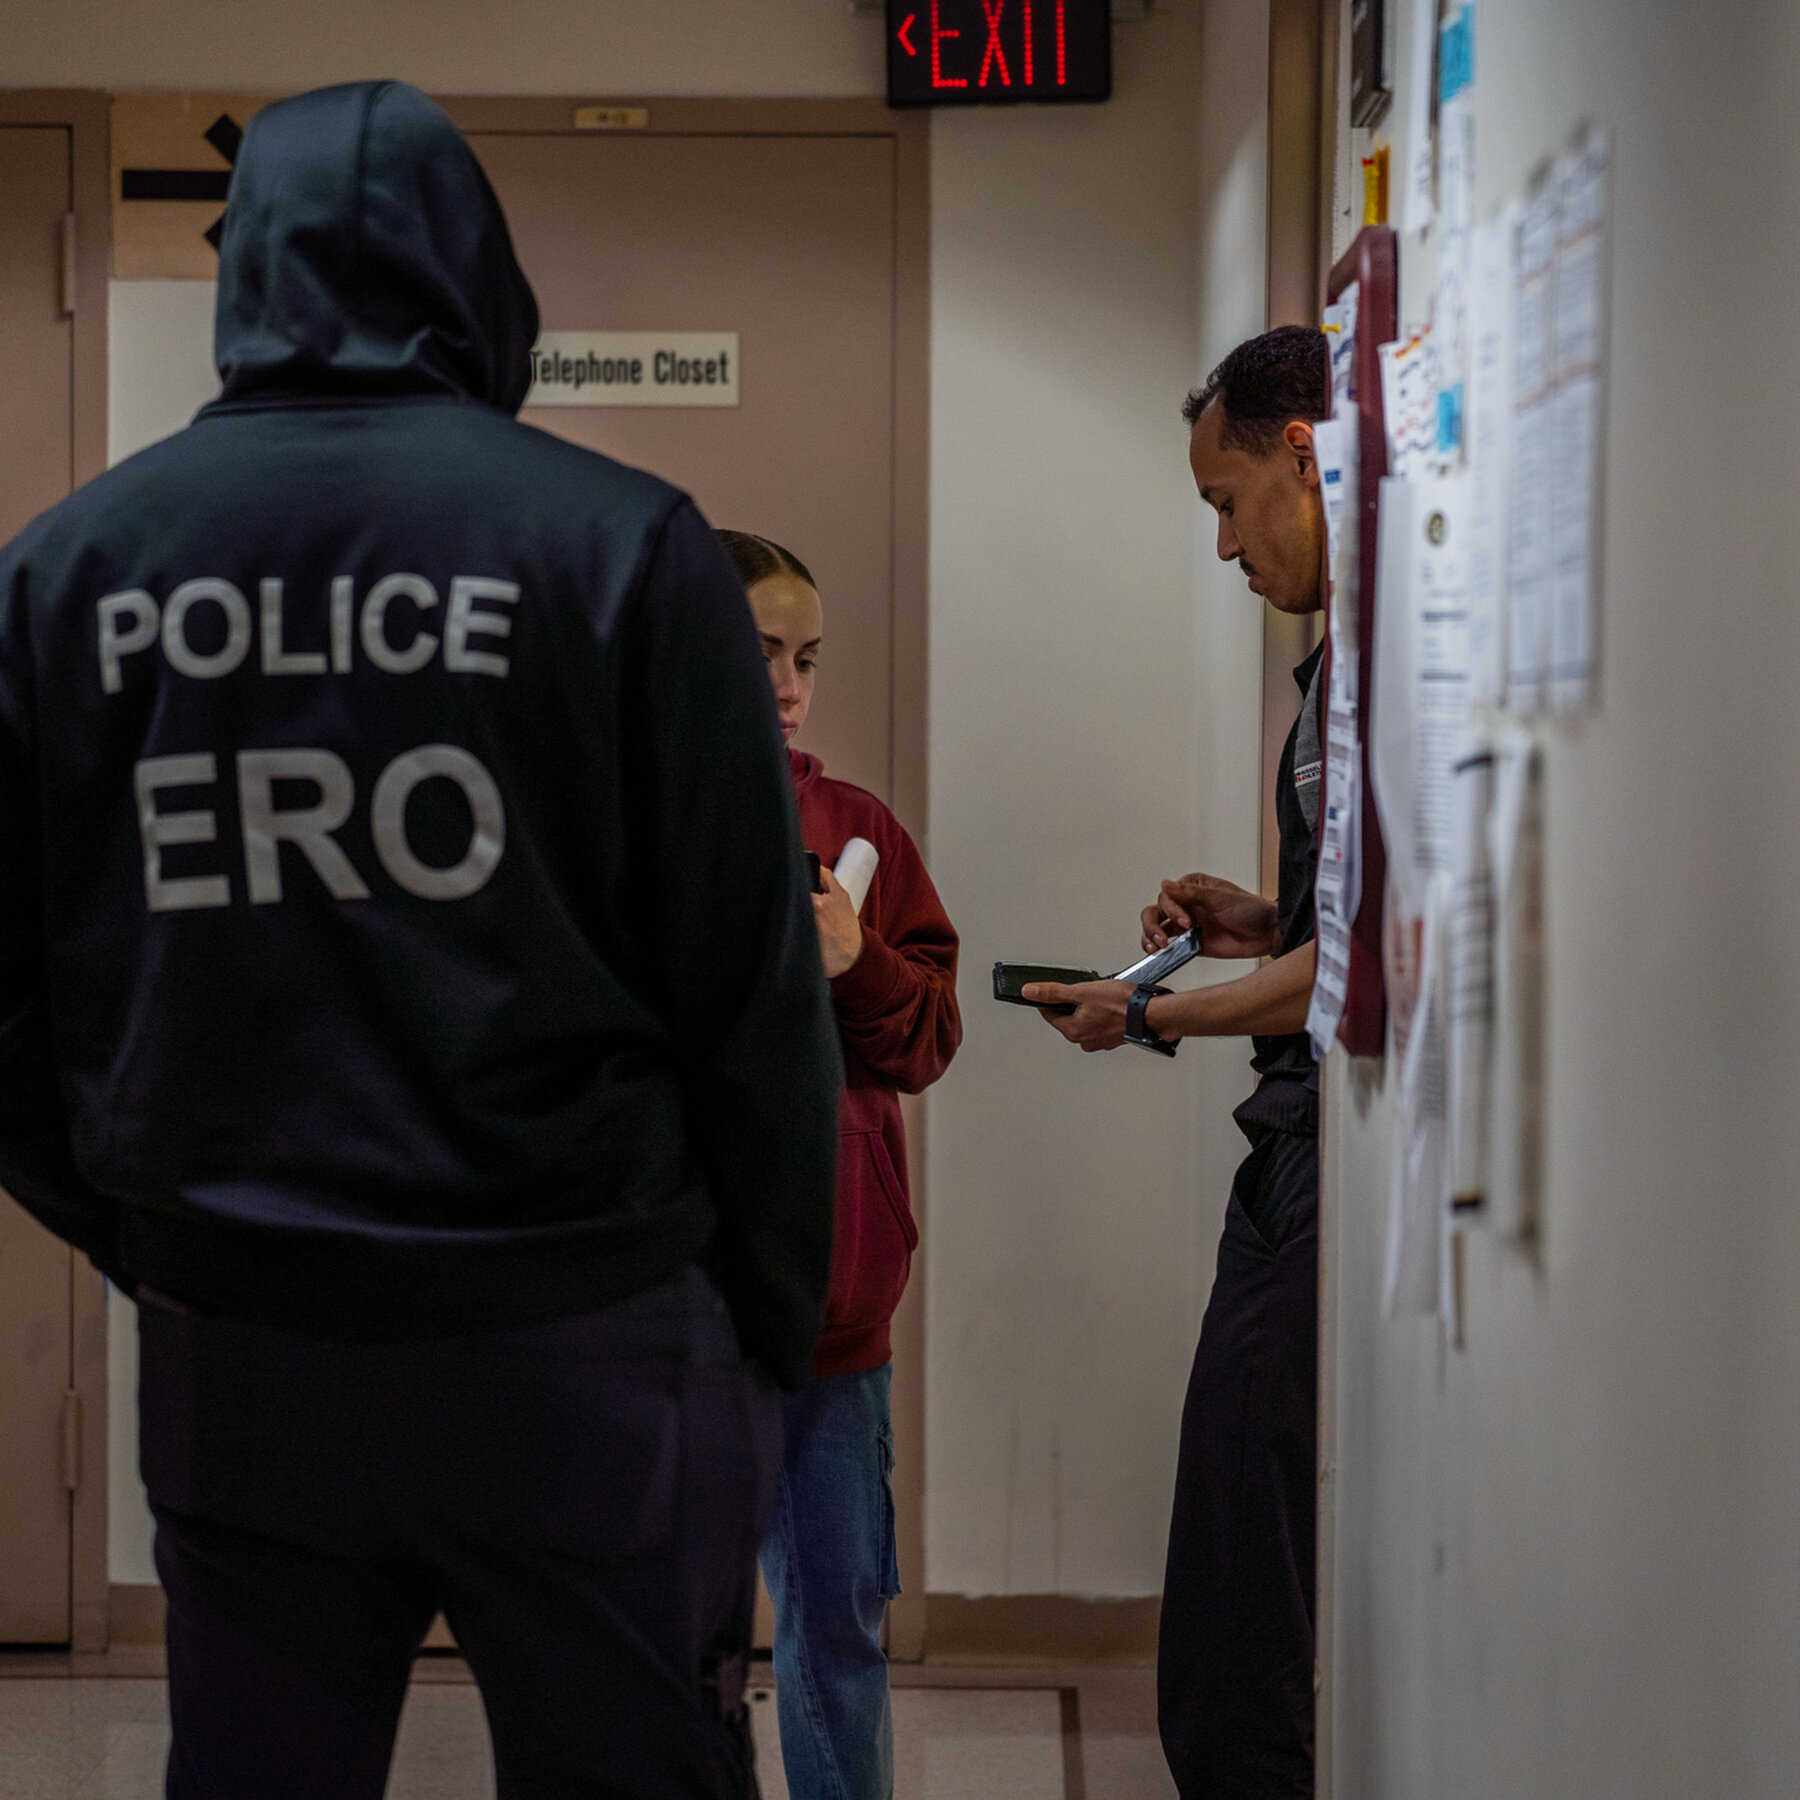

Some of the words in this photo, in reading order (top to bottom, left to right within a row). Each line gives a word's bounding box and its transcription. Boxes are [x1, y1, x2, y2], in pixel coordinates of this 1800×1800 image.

[530, 350, 642, 390] Telephone
[654, 350, 729, 384] Closet
[97, 573, 521, 695] POLICE
[133, 743, 506, 912] ERO
